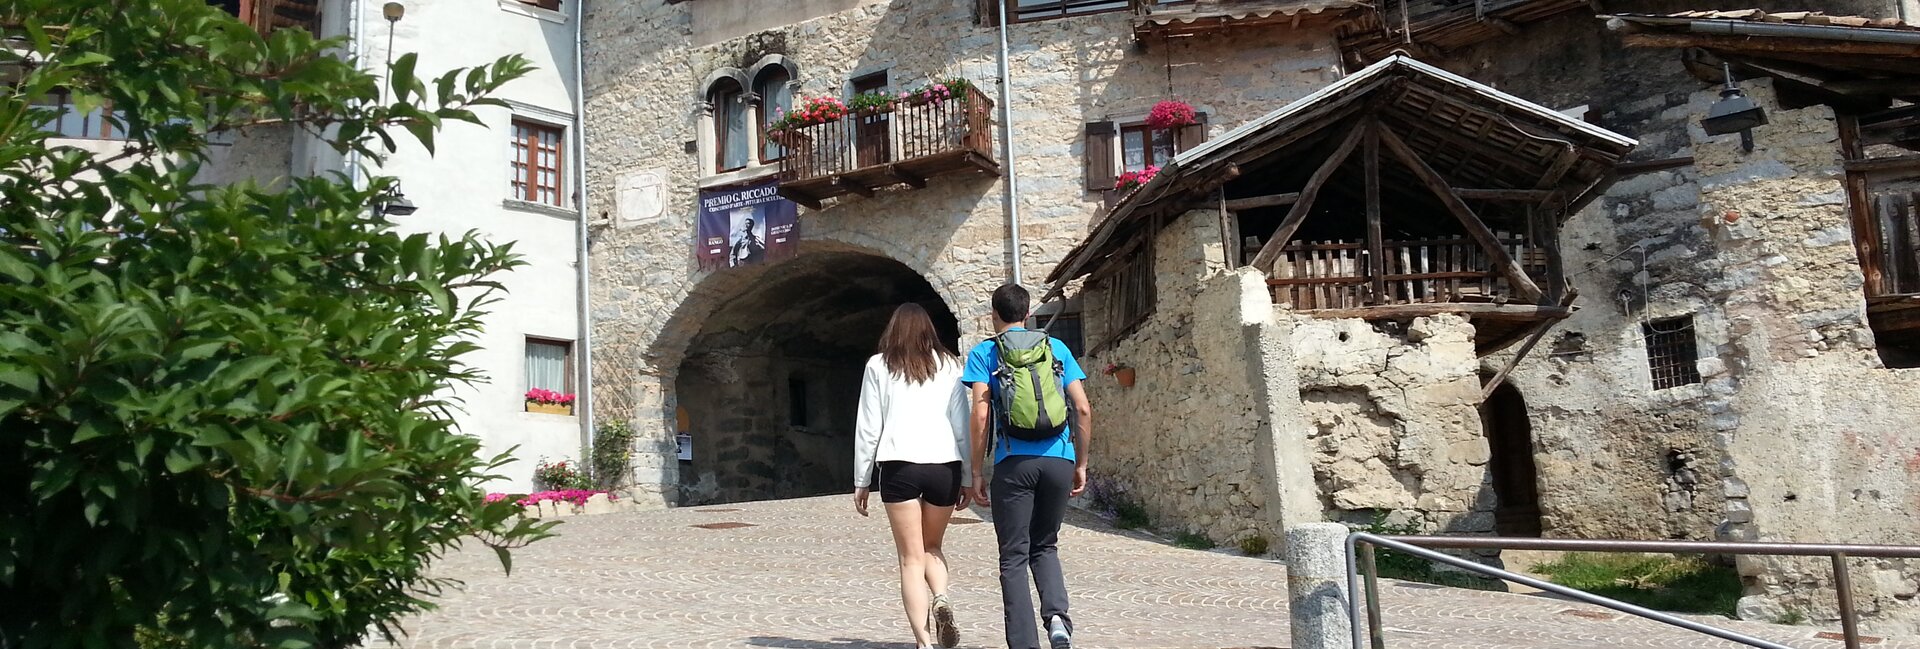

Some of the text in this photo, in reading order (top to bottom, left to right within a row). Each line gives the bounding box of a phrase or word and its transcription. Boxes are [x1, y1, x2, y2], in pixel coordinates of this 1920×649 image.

[704, 186, 776, 207] PREMIO G. RICCADO
